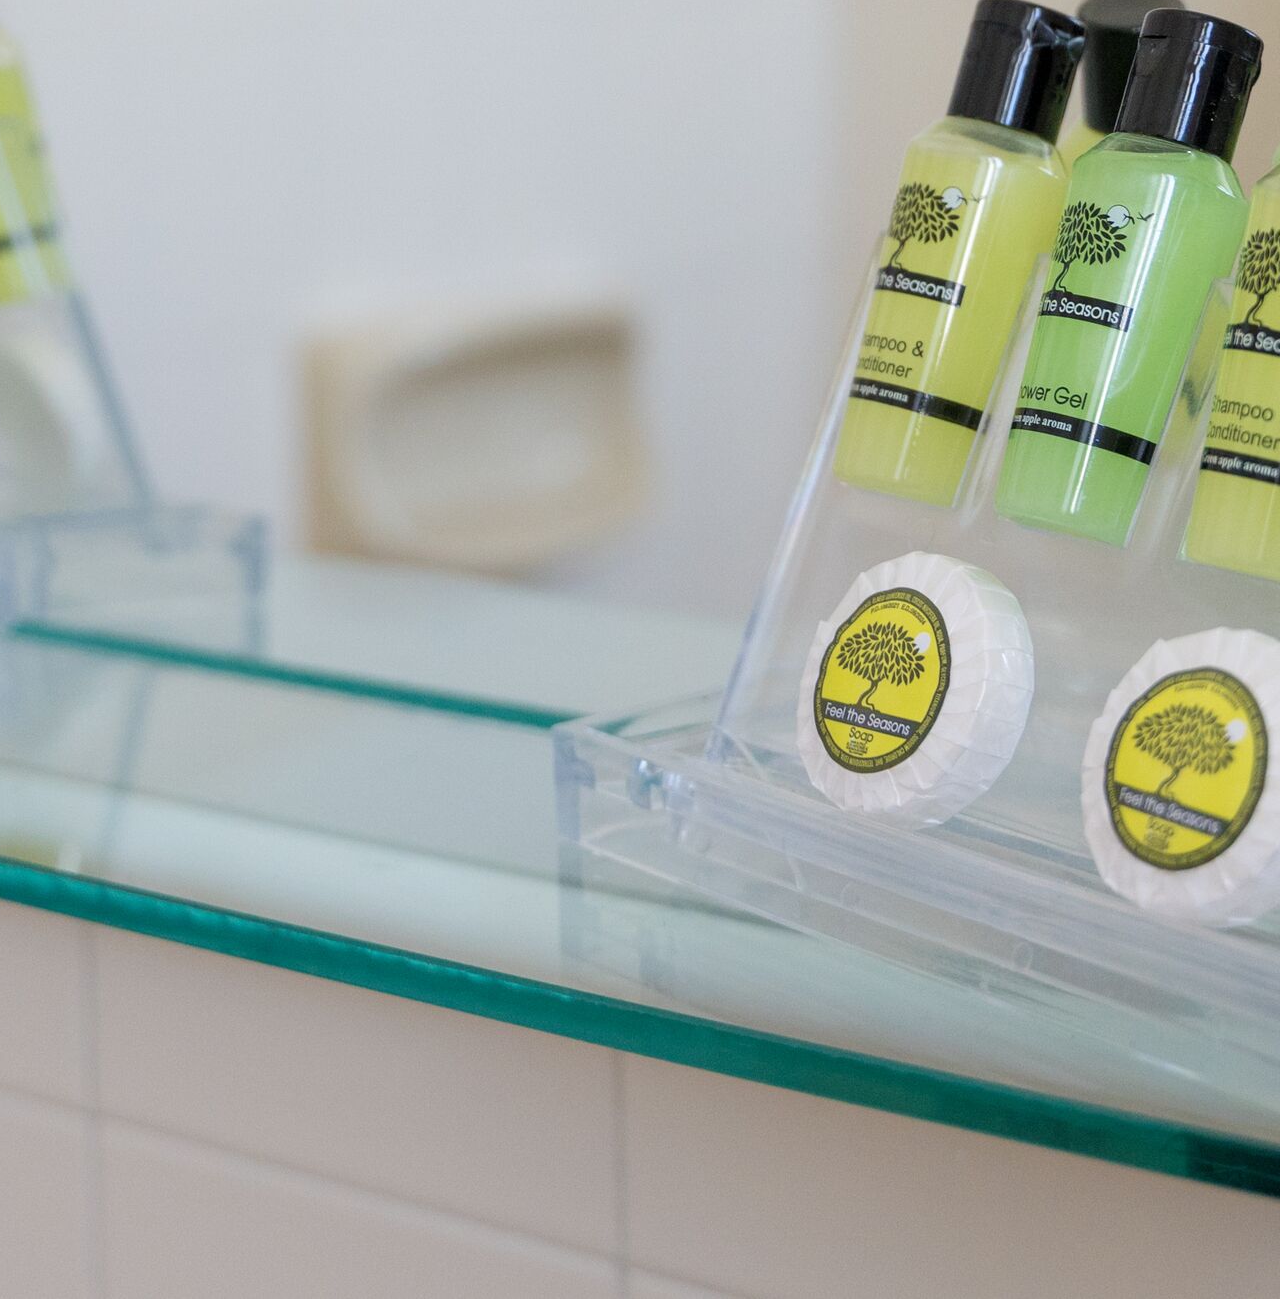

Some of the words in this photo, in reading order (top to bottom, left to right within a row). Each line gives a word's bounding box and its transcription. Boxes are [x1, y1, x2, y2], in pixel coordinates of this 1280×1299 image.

[895, 273, 954, 301] Seasons
[1059, 297, 1120, 324] Seasons
[863, 333, 907, 353] ampoo
[911, 340, 925, 358] &
[1233, 328, 1253, 348] the
[878, 387, 909, 403] aroma
[1020, 385, 1051, 402] ower
[1053, 386, 1088, 410] Gel
[1041, 417, 1073, 432] aroma
[1242, 461, 1280, 479] aroma
[824, 701, 846, 721] Feel
[847, 705, 866, 725] the
[867, 714, 911, 736] Seasons
[848, 727, 874, 744] Soap
[1119, 787, 1142, 809] Feel
[1145, 795, 1164, 814] the
[1166, 802, 1221, 834] Seasons
